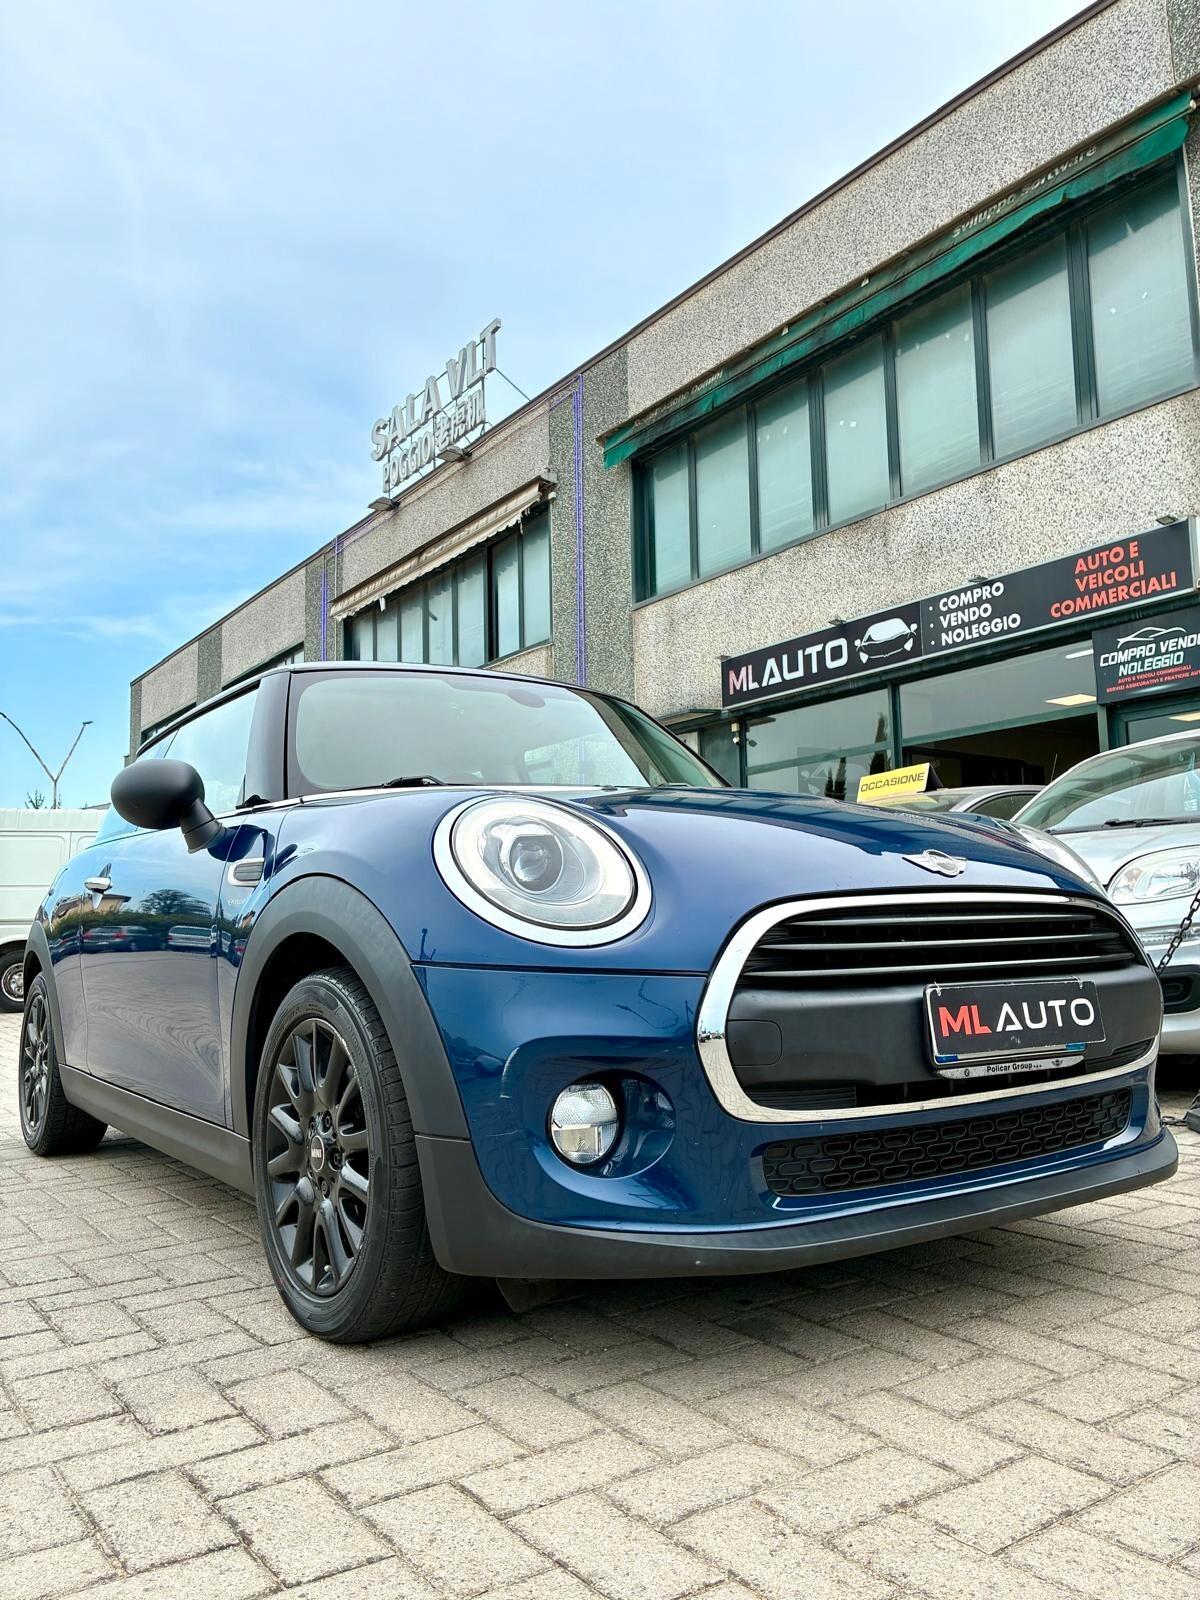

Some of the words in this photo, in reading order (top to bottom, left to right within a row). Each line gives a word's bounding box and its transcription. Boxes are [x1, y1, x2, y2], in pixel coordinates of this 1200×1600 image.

[371, 375, 442, 461] SALA
[446, 317, 501, 400] VLT
[383, 431, 435, 493] POGGIO
[1075, 546, 1125, 574] AUTO
[1129, 541, 1139, 559] E
[1075, 560, 1145, 592] VEICOLI
[939, 582, 1005, 612] COMPRO
[1050, 571, 1177, 618] COMMERCIALI
[939, 603, 992, 629] VENDO
[941, 613, 1021, 647] NOLEGGIO
[1100, 643, 1156, 667] COMPRO
[1119, 651, 1184, 677] NOLEGGIO
[860, 772, 925, 793] OCCASIONE
[986, 1064, 1011, 1073] Policar
[1012, 1062, 1033, 1071] Group
